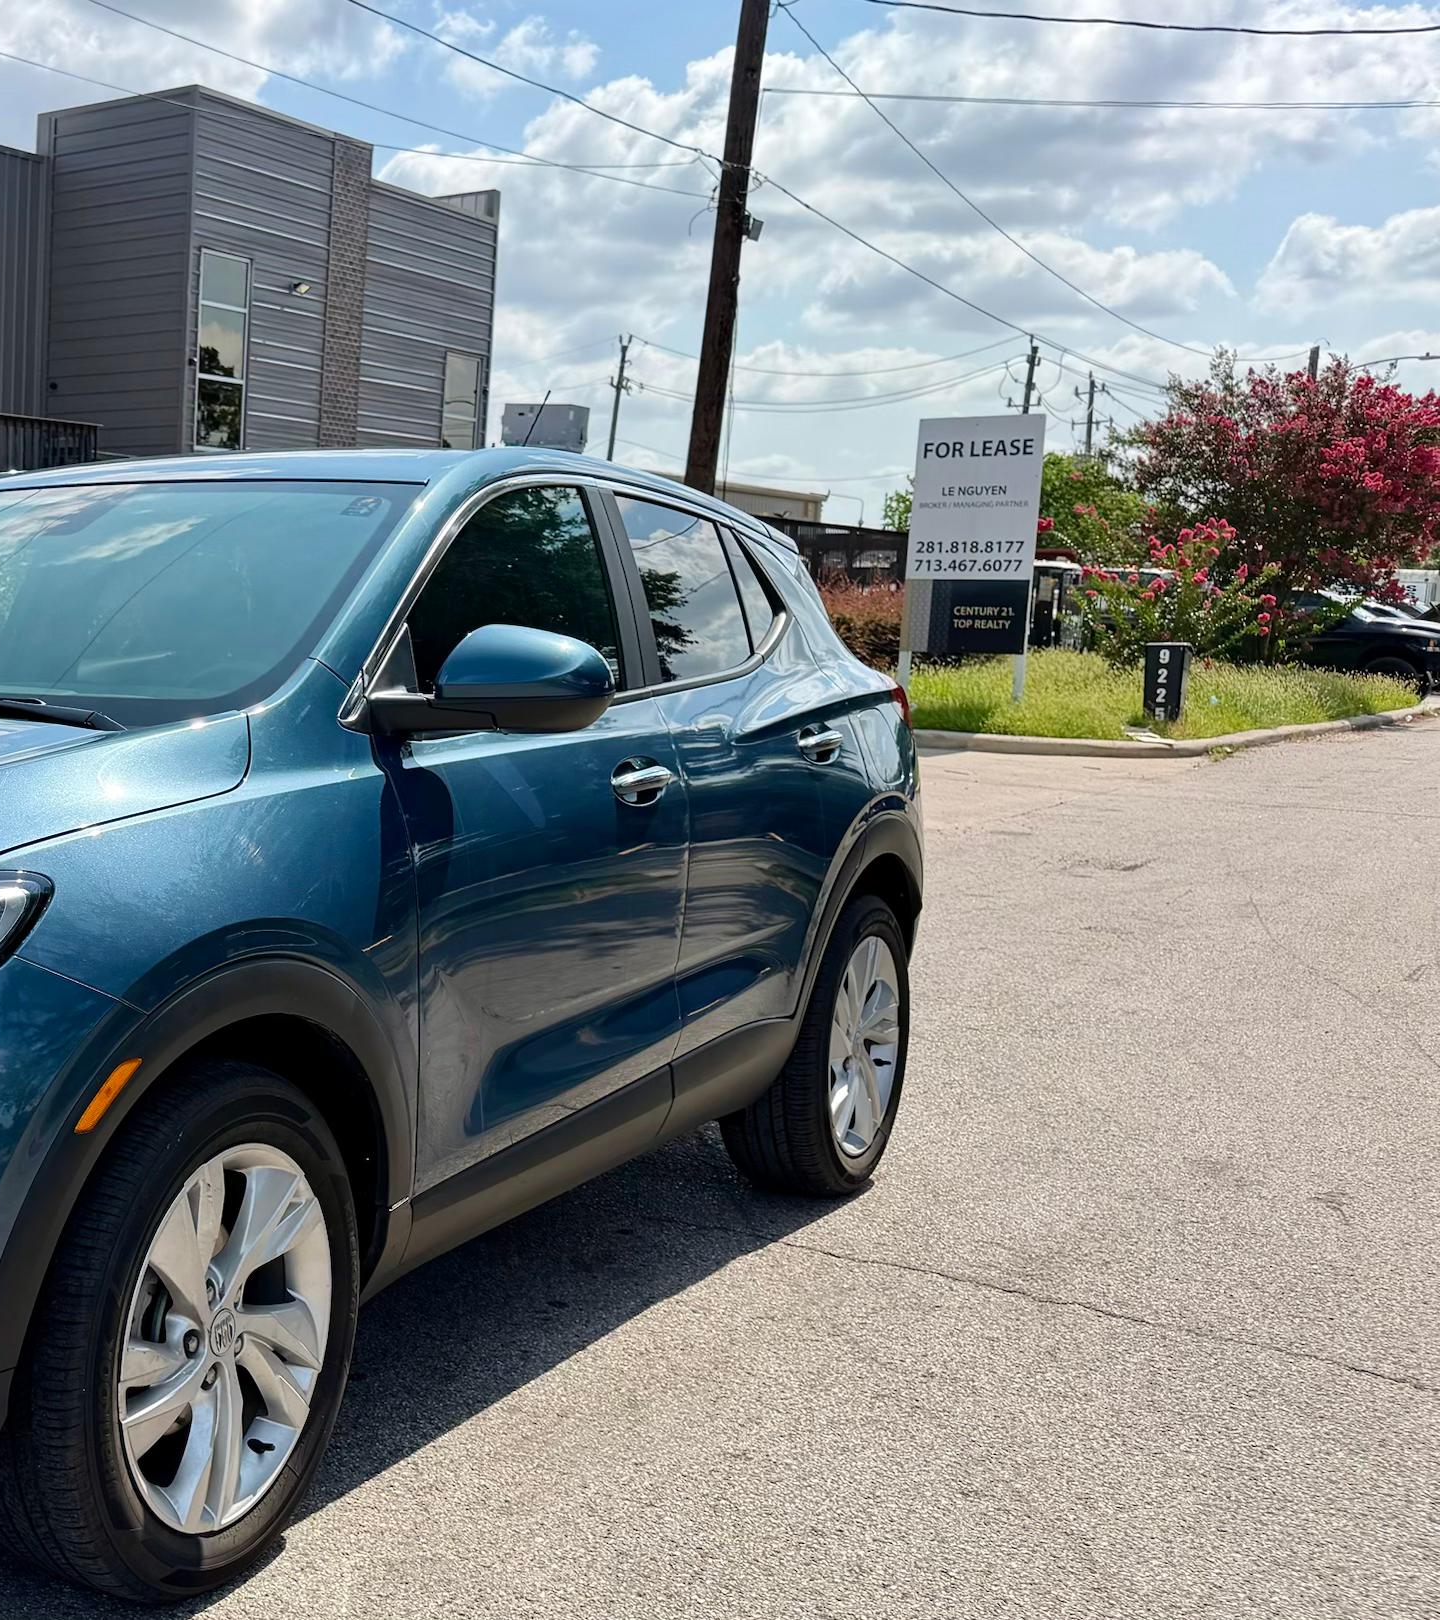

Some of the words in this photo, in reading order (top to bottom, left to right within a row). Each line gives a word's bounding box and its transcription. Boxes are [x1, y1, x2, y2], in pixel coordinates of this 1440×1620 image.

[923, 441, 964, 459] FOR
[970, 438, 1034, 457] LEASE
[941, 486, 955, 497] LE
[958, 485, 1007, 496] NGUYEN
[916, 541, 1025, 554] 281.818.8177
[914, 559, 1023, 572] 713.467.6077
[953, 606, 1000, 616] CENTURY
[952, 619, 973, 629] TOP
[974, 619, 1011, 629] REALTY
